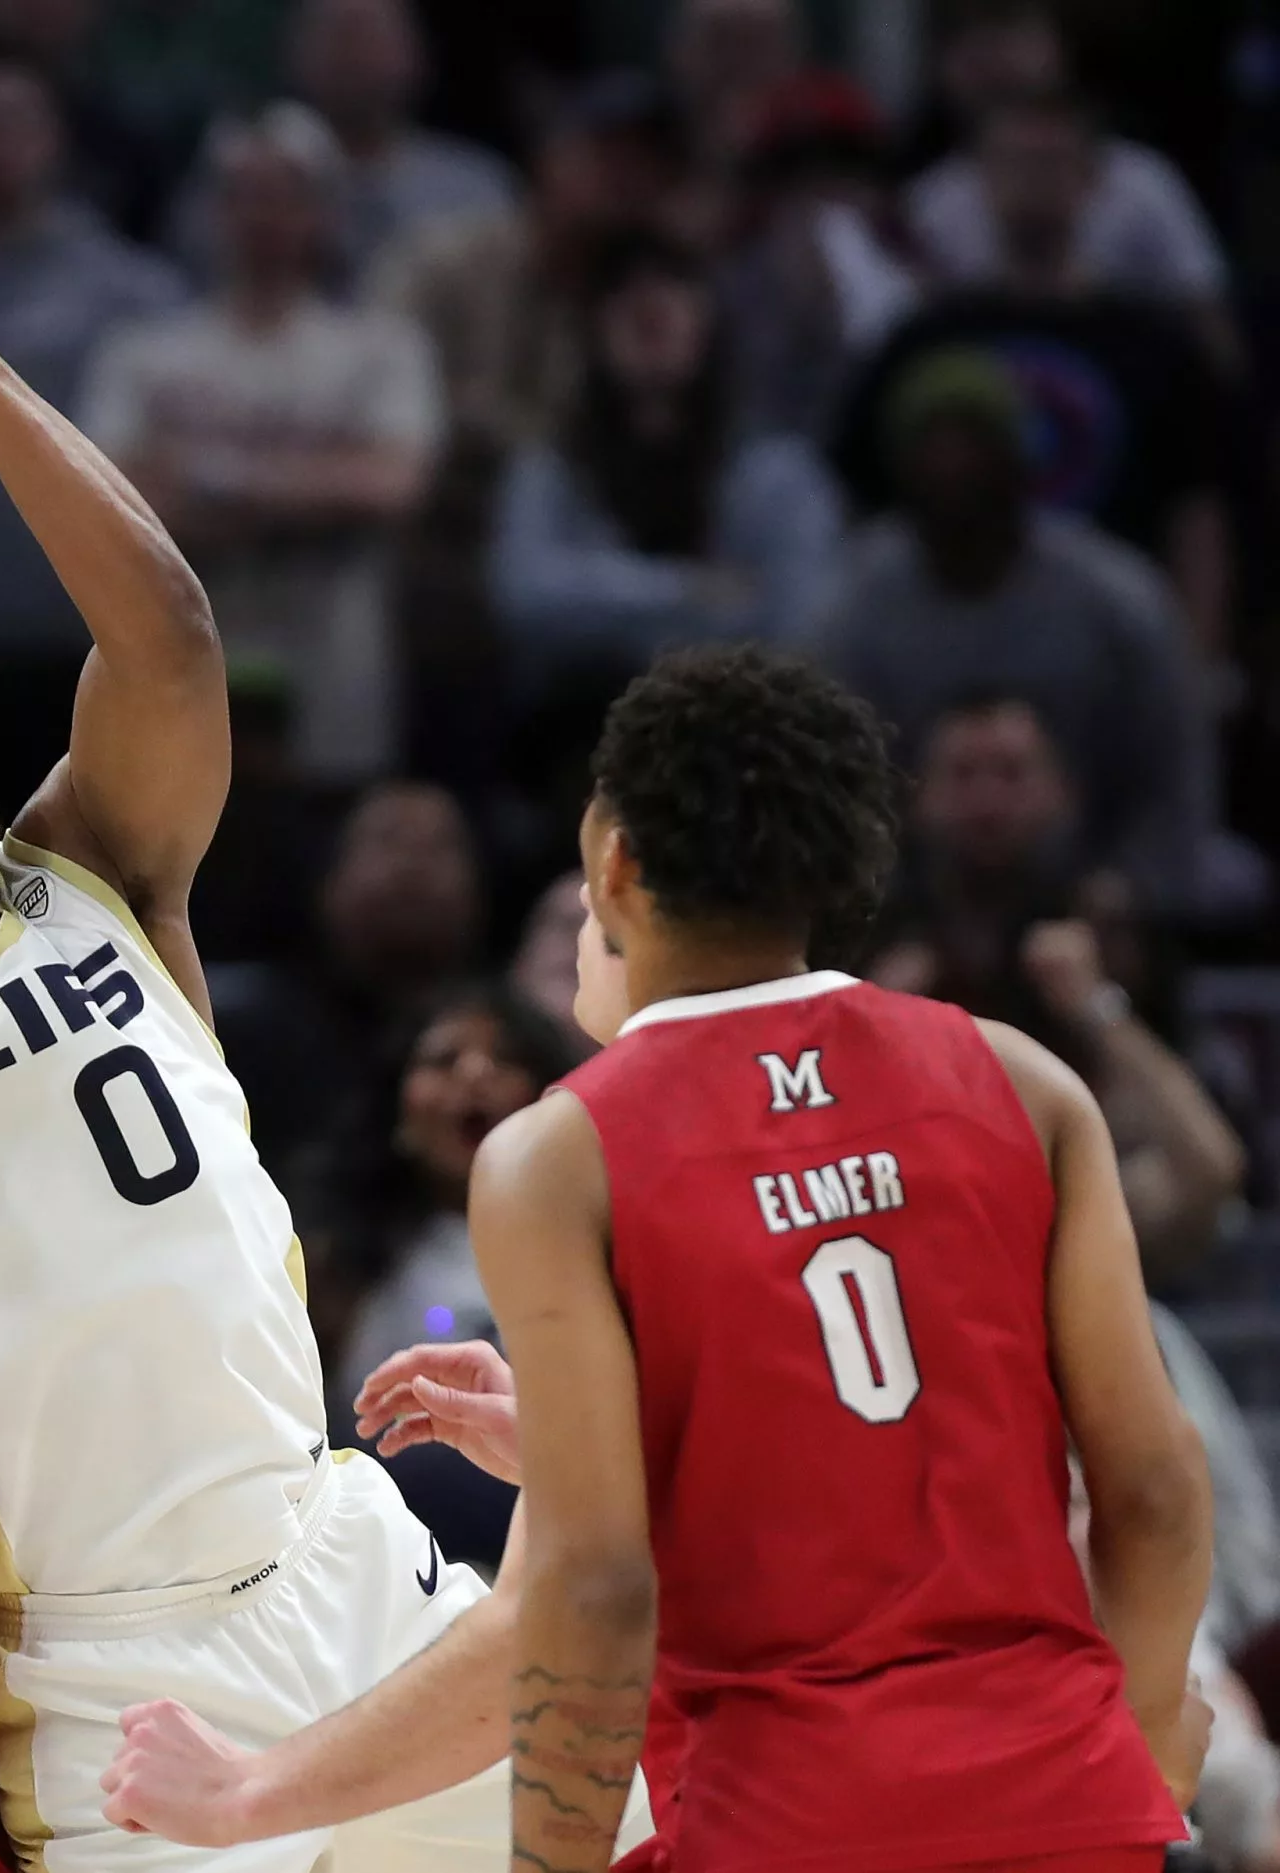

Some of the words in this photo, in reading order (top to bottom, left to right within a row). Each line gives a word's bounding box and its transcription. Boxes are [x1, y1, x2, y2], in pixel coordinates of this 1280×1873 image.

[754, 1047, 838, 1113] M
[73, 1044, 200, 1206] 0
[753, 1150, 906, 1235] ELMER
[801, 1233, 921, 1425] 0
[230, 1560, 279, 1595] AKRON
